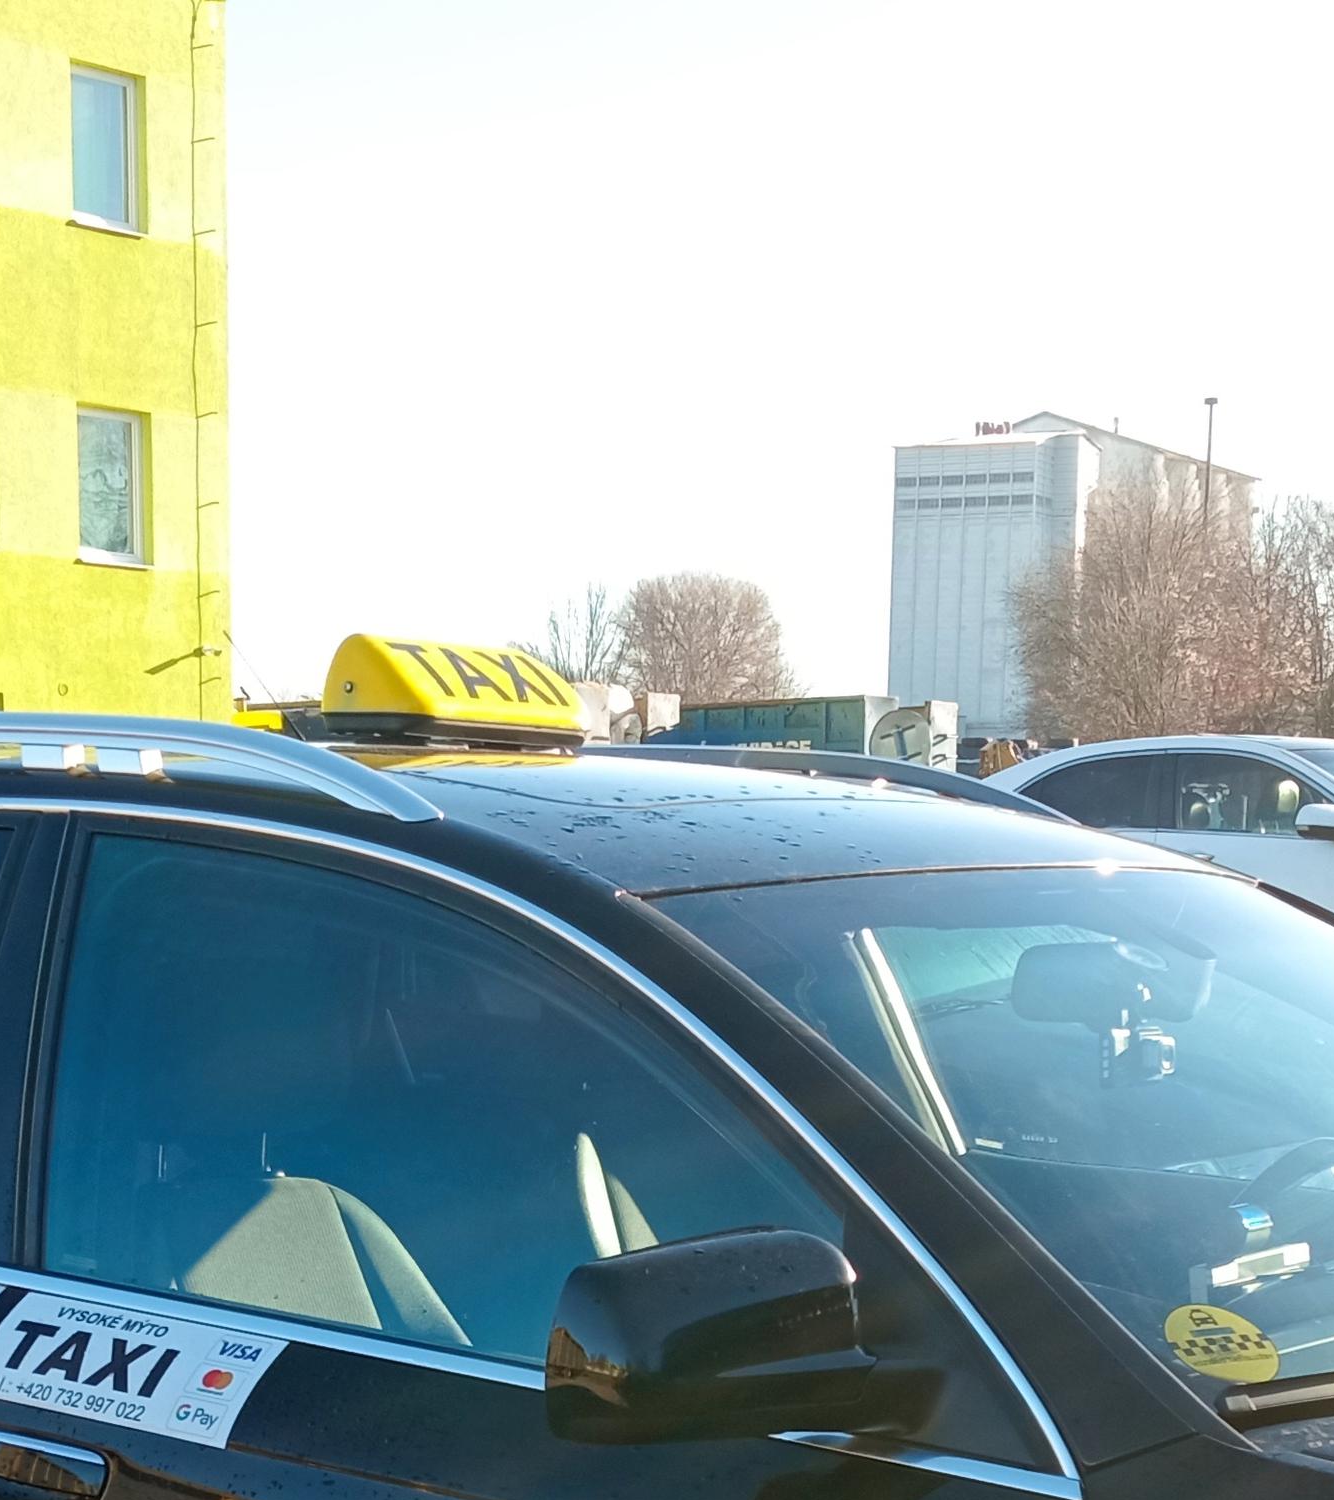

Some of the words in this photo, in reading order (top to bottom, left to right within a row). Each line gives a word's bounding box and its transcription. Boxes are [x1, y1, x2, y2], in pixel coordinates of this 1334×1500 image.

[384, 641, 570, 707] TAXI
[57, 1306, 124, 1329] VYSOKÉ
[120, 1319, 169, 1338] MÝTO
[4, 1320, 181, 1399] TAXI
[218, 1340, 263, 1362] VISA
[16, 1384, 53, 1402] +420
[54, 1387, 83, 1408] 732
[83, 1394, 115, 1415] 997
[115, 1402, 146, 1422] 022
